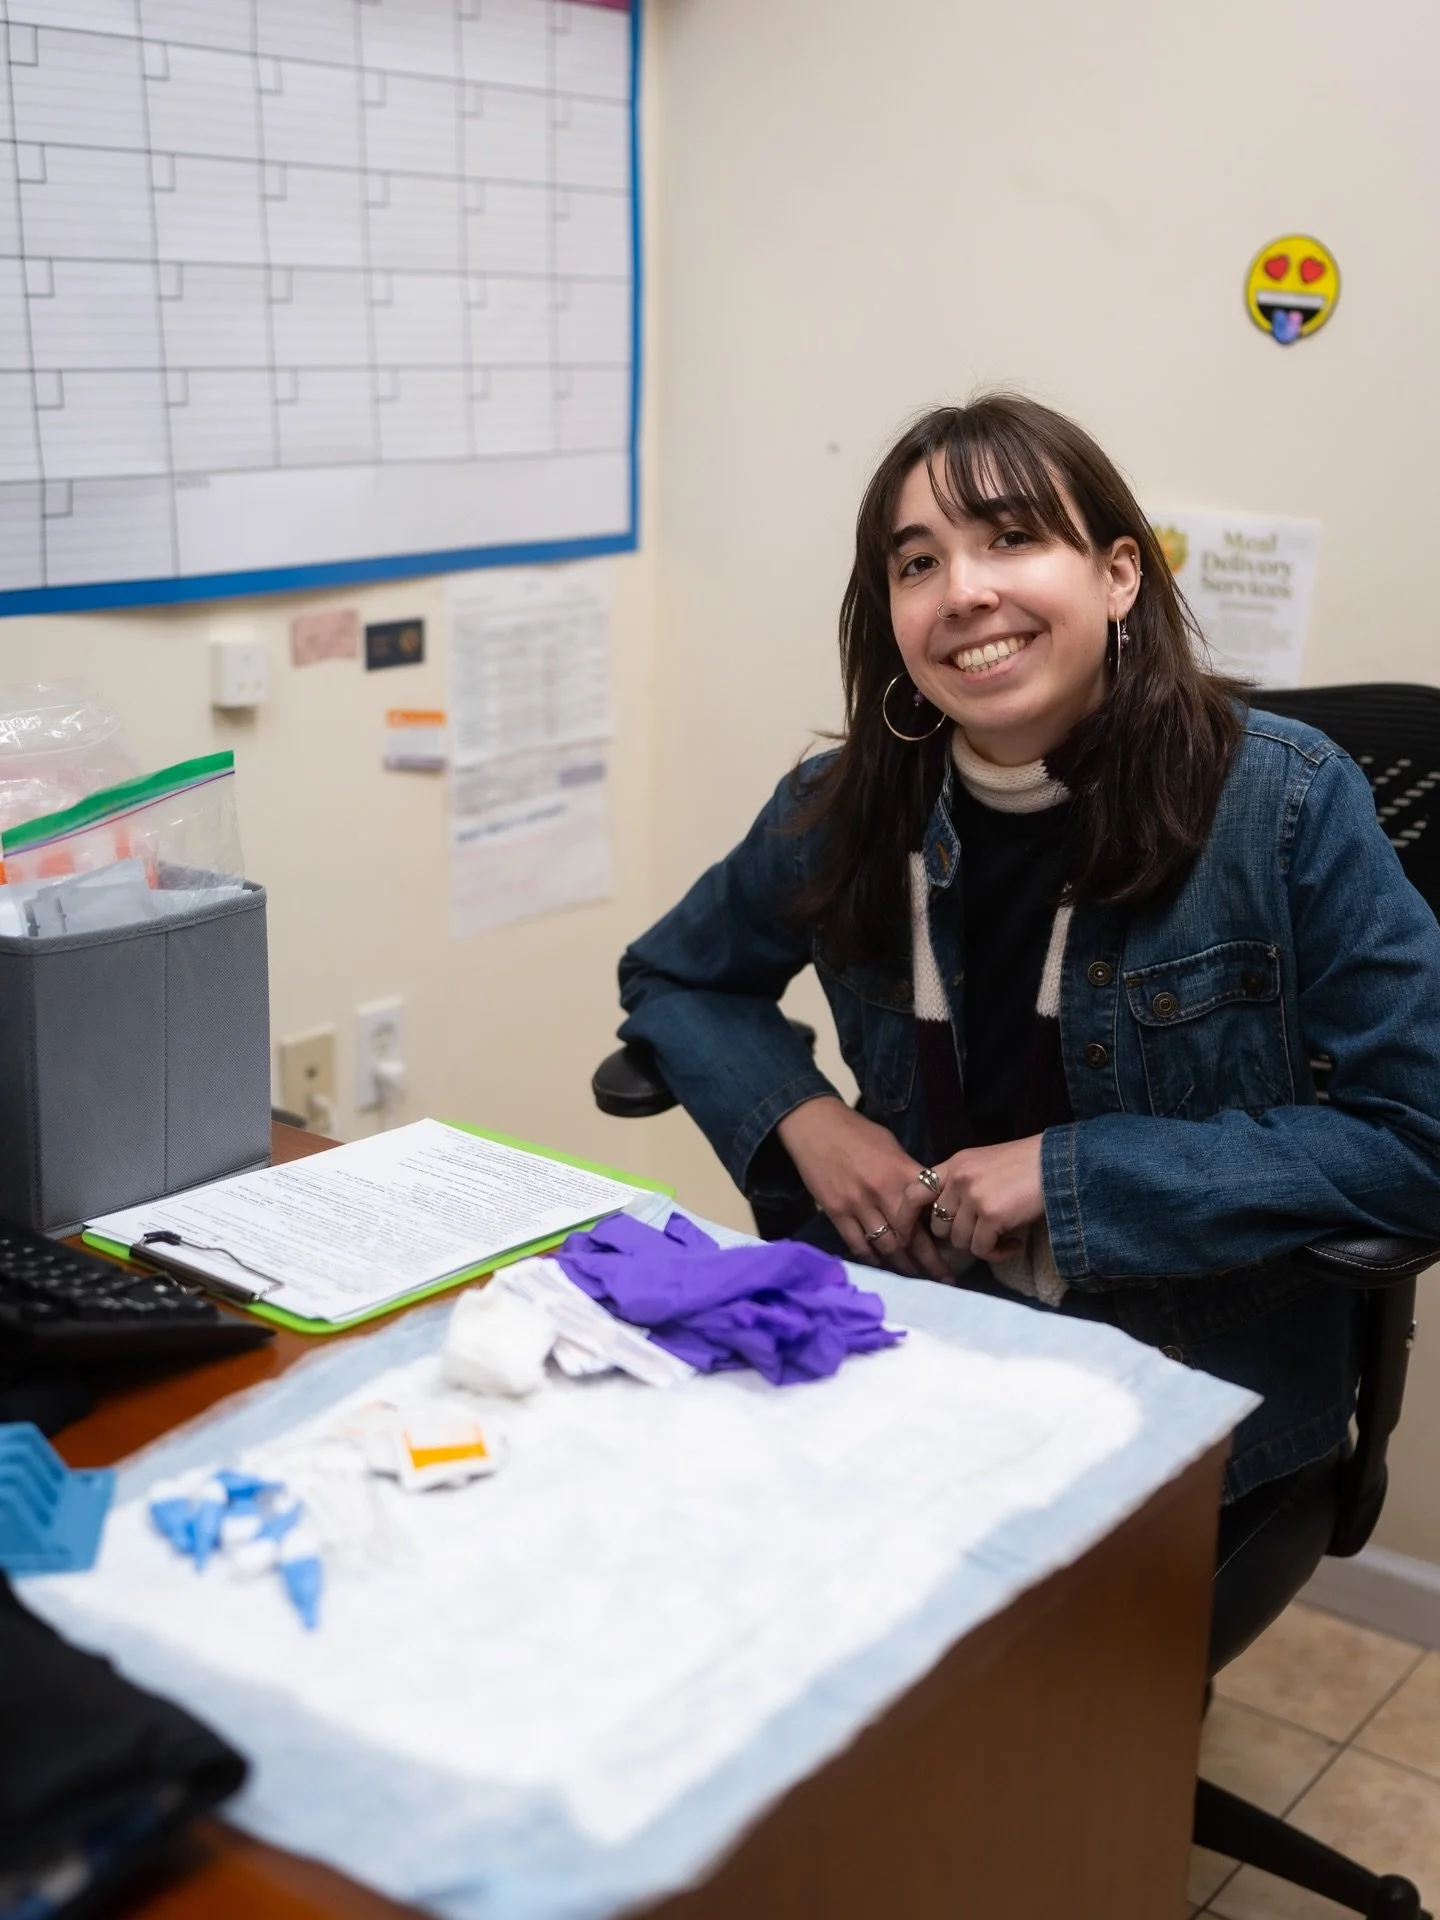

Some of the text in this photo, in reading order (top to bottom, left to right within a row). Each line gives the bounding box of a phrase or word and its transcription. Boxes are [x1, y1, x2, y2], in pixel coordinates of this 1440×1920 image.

[1223, 530, 1277, 553] Meal
[1202, 551, 1291, 583] Delivery
[1202, 576, 1293, 599] Services
